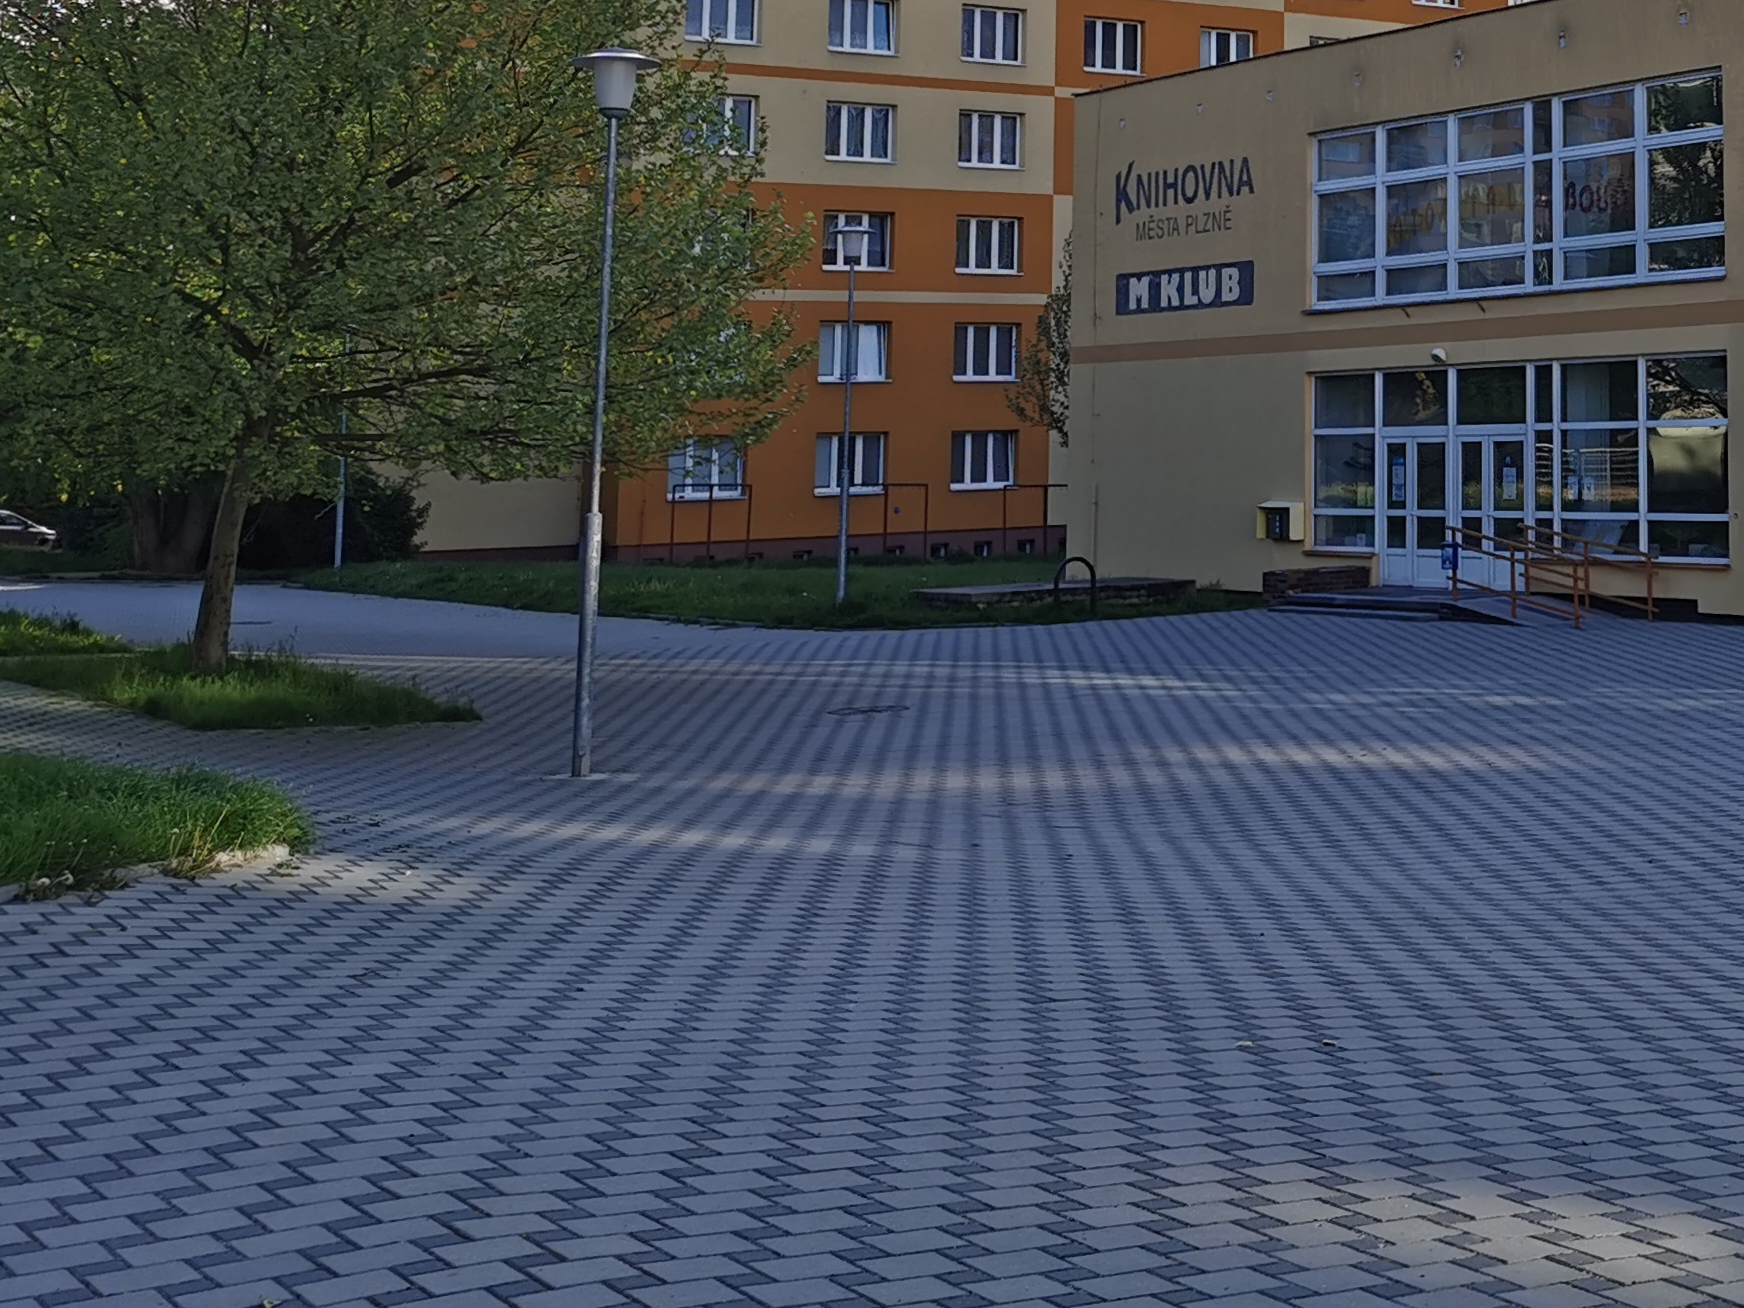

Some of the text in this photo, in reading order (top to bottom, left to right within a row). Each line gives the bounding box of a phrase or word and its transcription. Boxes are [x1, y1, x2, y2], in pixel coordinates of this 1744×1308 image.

[1115, 159, 1255, 226] KNIHOVNA
[1136, 204, 1233, 242] MĚSTA PLZNĚ
[1129, 267, 1241, 310] M KLUB
